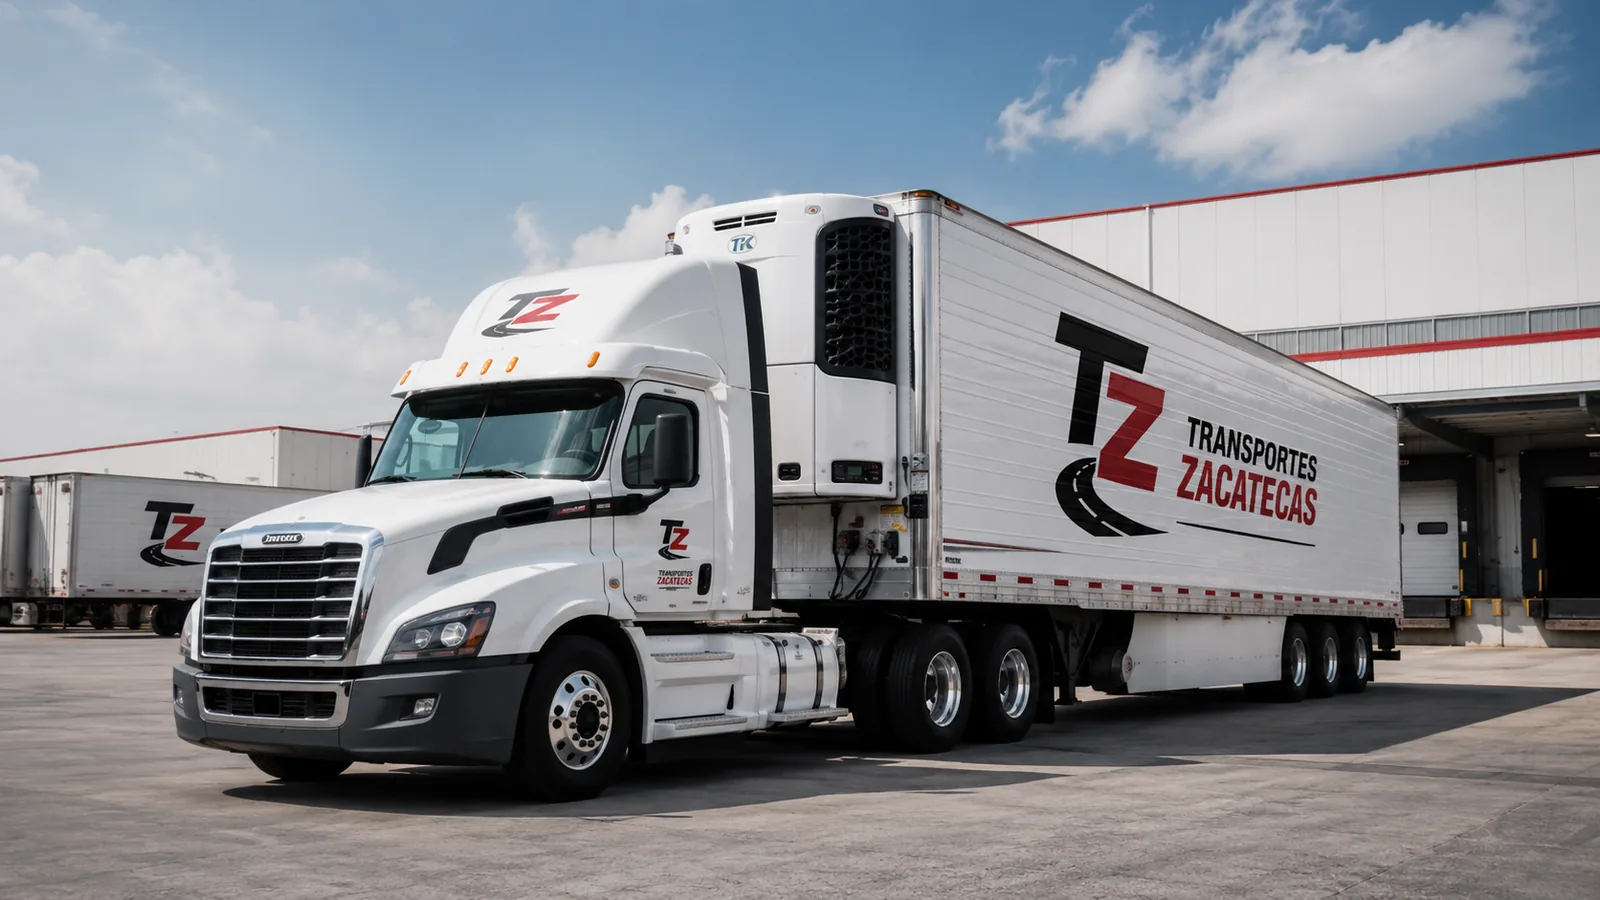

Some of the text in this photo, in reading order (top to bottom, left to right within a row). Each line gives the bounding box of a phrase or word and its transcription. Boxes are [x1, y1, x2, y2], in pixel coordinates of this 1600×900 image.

[731, 235, 755, 252] TK
[498, 288, 580, 325] TZ
[1055, 311, 1165, 492] TZ
[1187, 416, 1317, 482] TRANSPORTES
[1176, 454, 1317, 526] ZACATECAS
[144, 500, 206, 550] TZ
[660, 519, 690, 550] TZ
